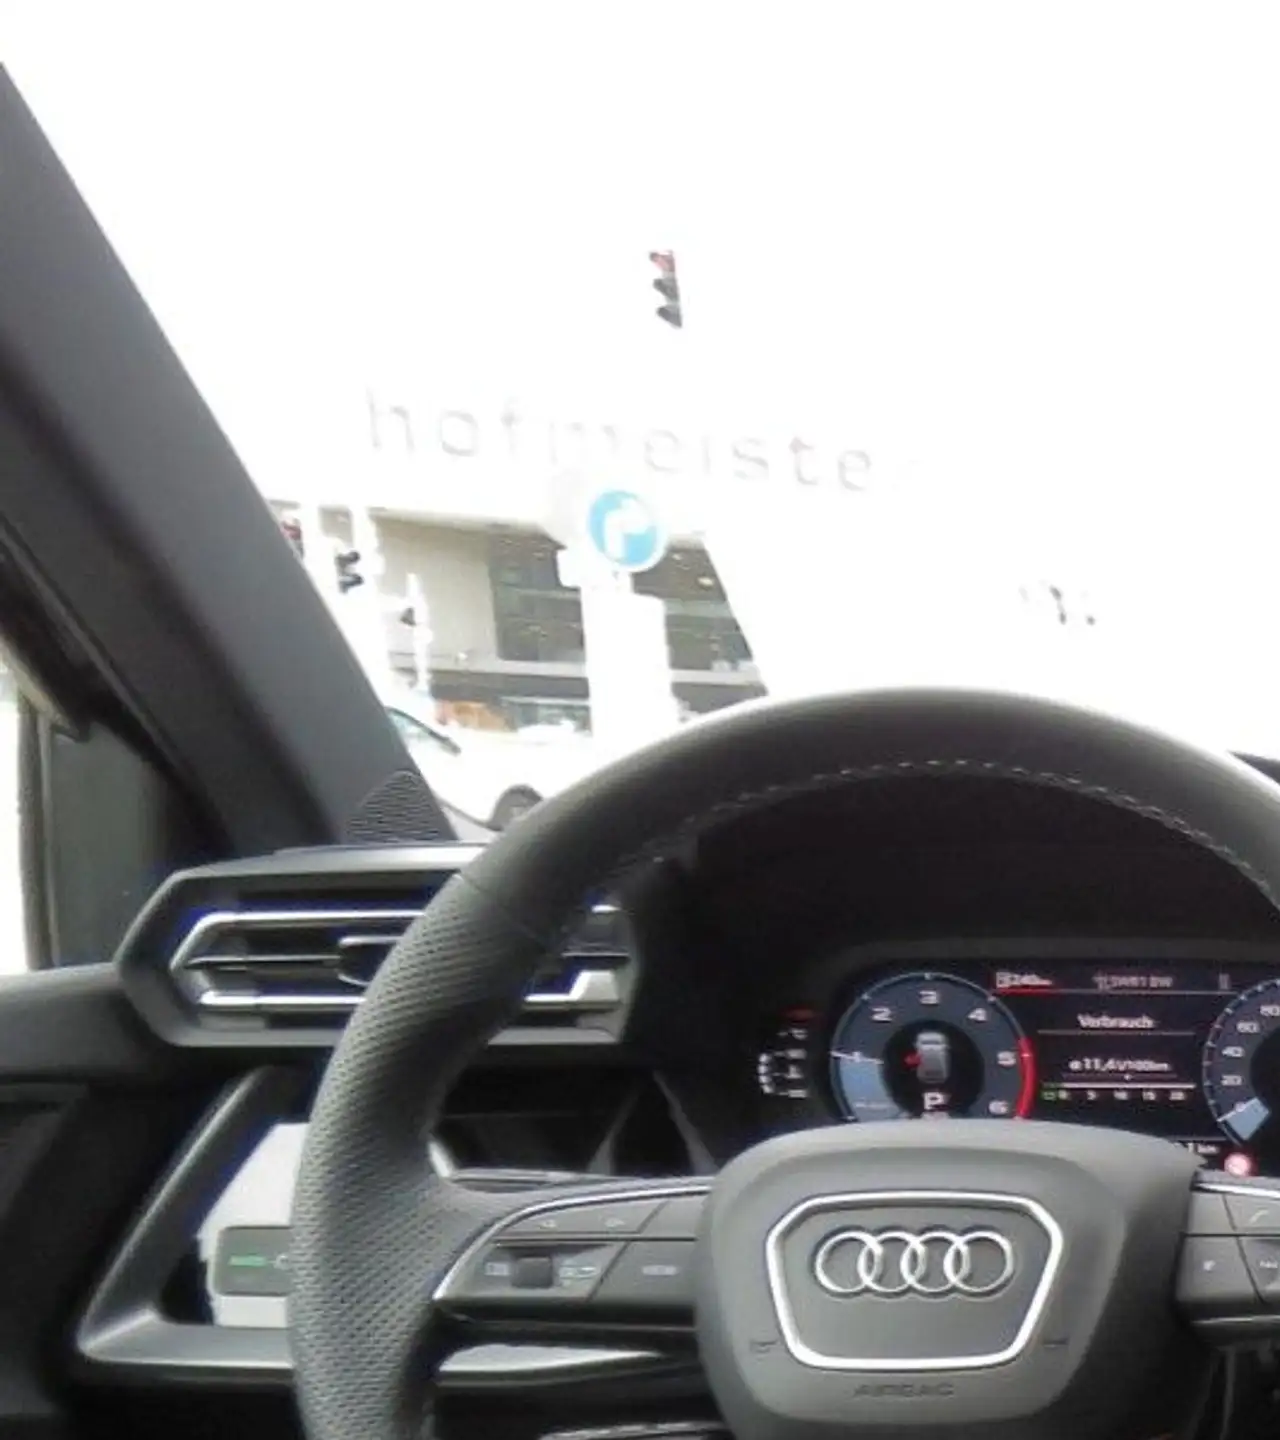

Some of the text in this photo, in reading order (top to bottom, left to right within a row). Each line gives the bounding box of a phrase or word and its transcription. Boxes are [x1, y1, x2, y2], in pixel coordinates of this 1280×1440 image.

[364, 384, 921, 493] hofmeiste
[919, 990, 940, 1006] 3
[872, 1007, 892, 1022] 2
[967, 1008, 987, 1022] 4
[1077, 1012, 1155, 1029] Verbrauch
[1236, 1022, 1260, 1034] 60
[997, 1051, 1016, 1066] 5
[1222, 1047, 1245, 1059] 40
[1221, 1075, 1243, 1087] 20
[924, 1091, 946, 1111] P
[988, 1099, 1008, 1114] 6
